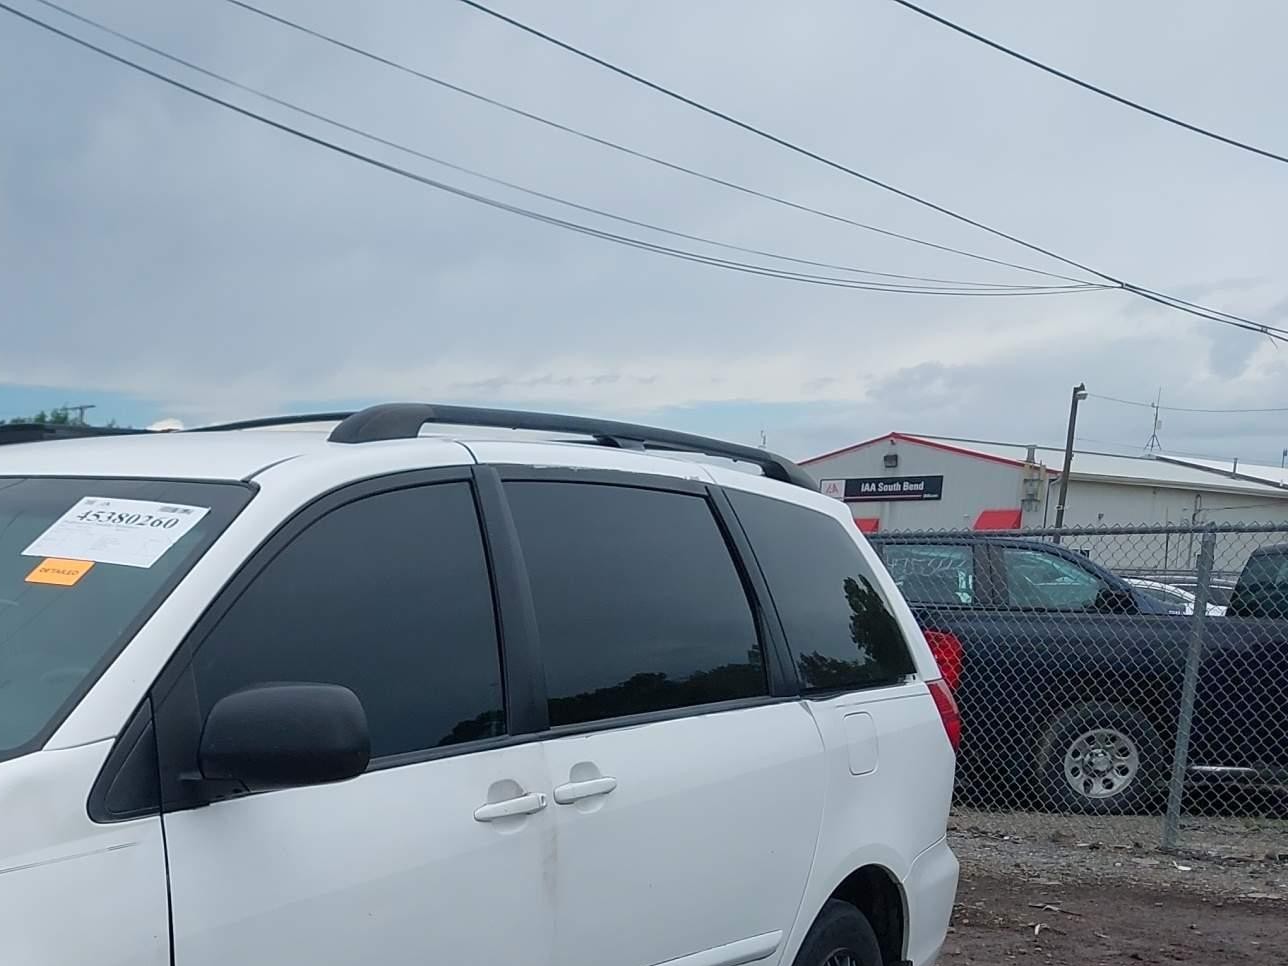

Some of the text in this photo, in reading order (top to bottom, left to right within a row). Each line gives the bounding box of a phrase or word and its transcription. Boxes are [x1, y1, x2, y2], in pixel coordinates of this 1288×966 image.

[861, 480, 925, 492] IAA South Bend
[76, 509, 180, 529] 45380260
